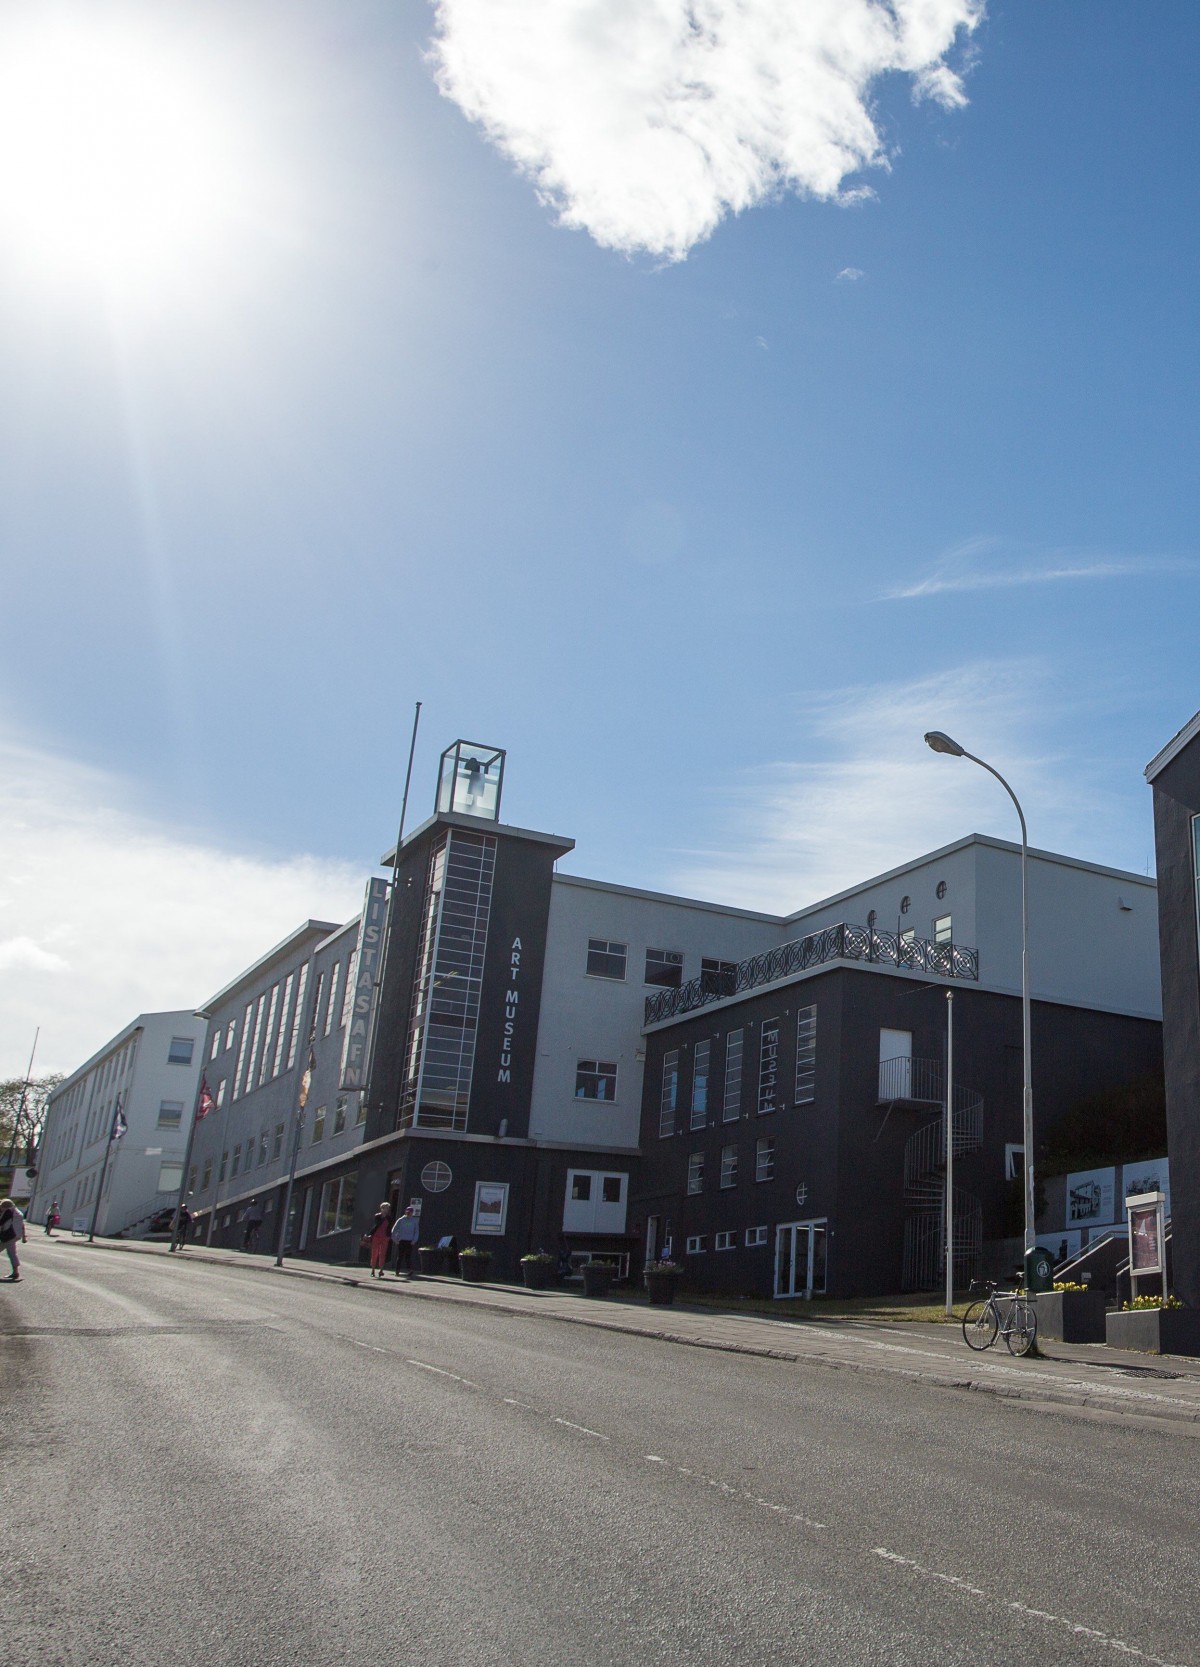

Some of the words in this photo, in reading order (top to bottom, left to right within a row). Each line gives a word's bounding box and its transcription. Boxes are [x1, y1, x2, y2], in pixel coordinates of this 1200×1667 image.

[345, 880, 383, 1086] LISTASAFN
[510, 937, 522, 980] ART
[497, 990, 518, 1083] MUSEUM
